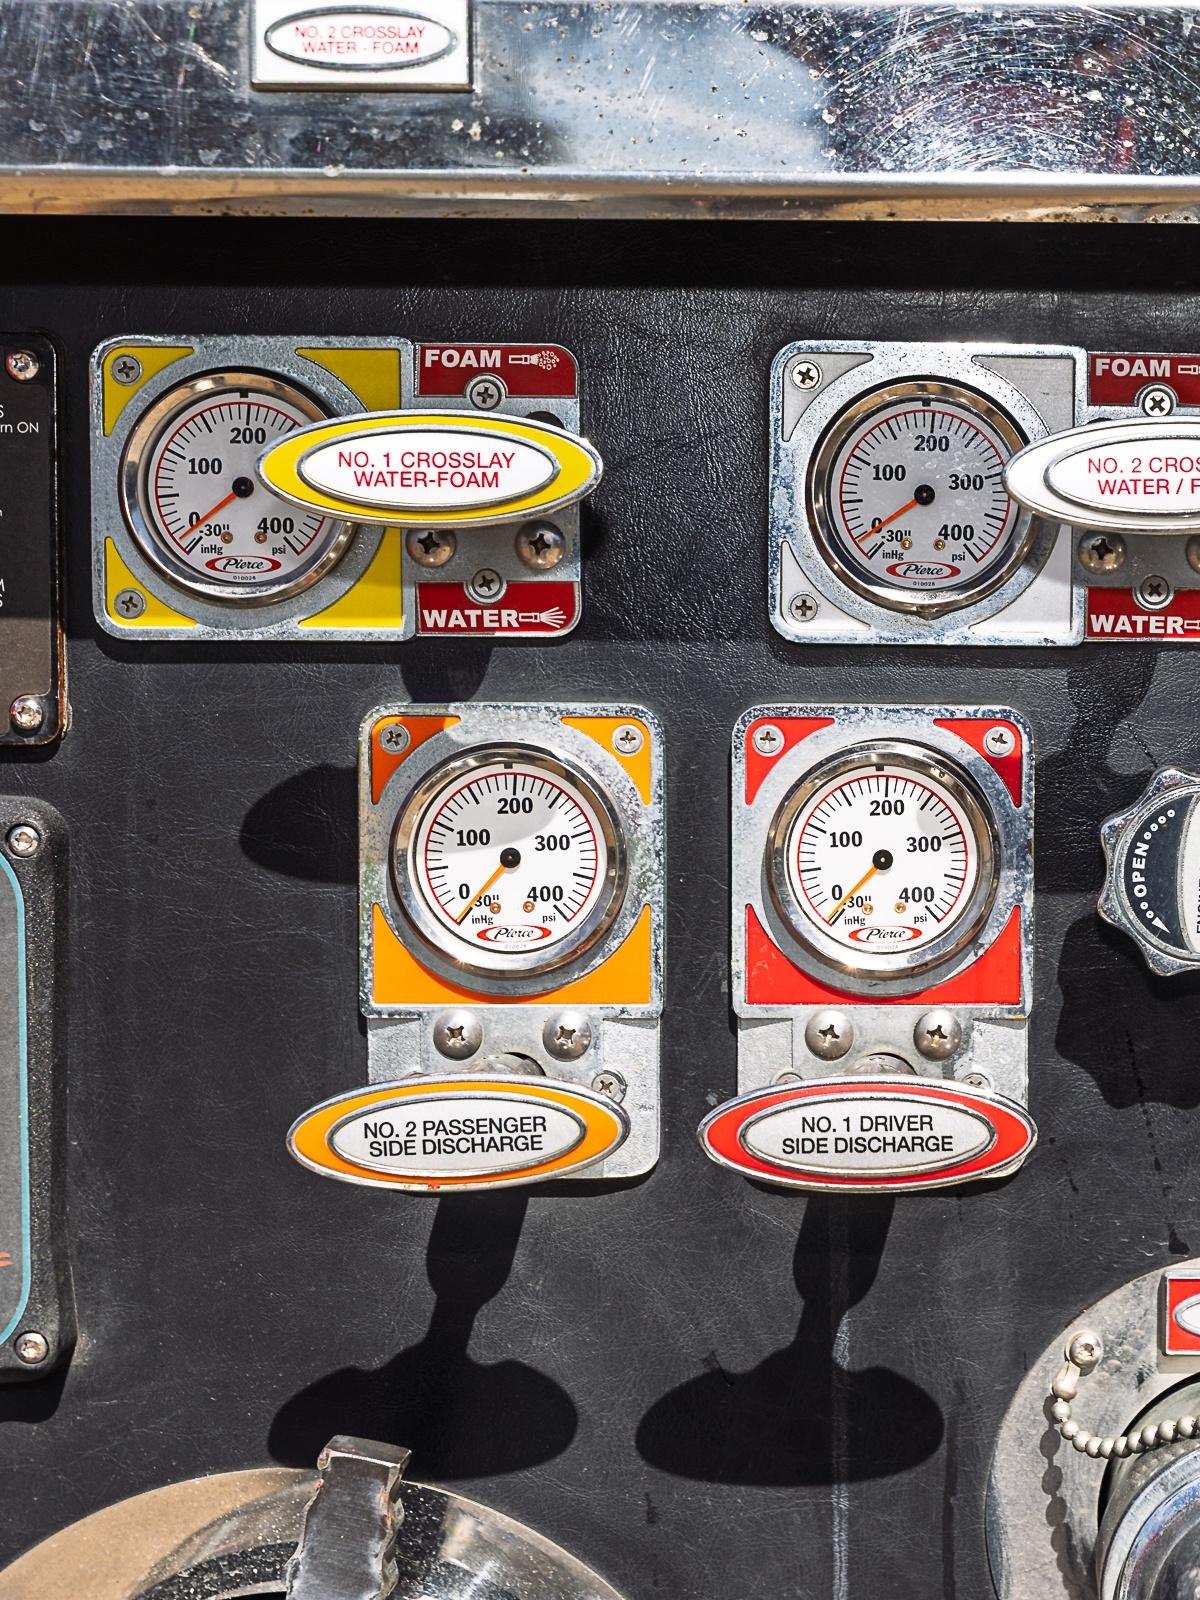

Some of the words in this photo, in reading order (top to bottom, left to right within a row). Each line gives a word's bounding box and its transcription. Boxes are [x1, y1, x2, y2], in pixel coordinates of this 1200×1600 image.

[328, 26, 336, 38] 2
[341, 26, 425, 38] CROSSLAY
[303, 42, 357, 54] WATER
[373, 42, 419, 54] FOAM
[425, 350, 501, 367] FOAM
[1095, 359, 1170, 377] FOAM
[17, 421, 39, 433] ON
[229, 427, 266, 444] 200
[914, 435, 950, 452] 200
[188, 458, 222, 474] 100
[338, 452, 375, 468] NO.
[383, 453, 390, 467] 1
[401, 452, 515, 468] CROSSLAY
[1088, 458, 1123, 474] NO.
[1131, 458, 1142, 473] 2
[354, 471, 499, 488] WATER-FOAM
[873, 465, 906, 481] 100
[949, 474, 984, 491] 300
[1098, 479, 1170, 495] WATER
[1176, 478, 1184, 495] /
[257, 517, 294, 534] 400
[938, 524, 974, 541] 400
[201, 544, 223, 555] inHg
[272, 545, 286, 555] psi
[882, 550, 904, 561] inHg
[952, 551, 965, 562] psi
[223, 558, 264, 570] Pierce
[903, 563, 943, 576] Pierce
[423, 609, 520, 628] WATER
[1090, 614, 1184, 635] WATER
[497, 797, 533, 814] 200
[869, 800, 904, 816] 200
[456, 829, 490, 846] 100
[535, 834, 570, 851] 300
[830, 831, 862, 848] 100
[906, 836, 942, 852] 300
[1131, 842, 1150, 898] OPEN
[459, 883, 470, 899] 0
[527, 885, 563, 902] 400
[831, 884, 842, 900] 0
[899, 887, 934, 903] 400
[471, 915, 494, 925] inHg
[542, 913, 556, 923] psi
[844, 916, 866, 926] inHg
[914, 914, 927, 923] psi
[866, 928, 905, 940] Pierce
[364, 1122, 400, 1139] NO.
[405, 1121, 417, 1137] 2
[423, 1116, 547, 1136] PASSENGER
[801, 1116, 837, 1133] NO.
[843, 1116, 850, 1132] 1
[860, 1115, 933, 1132] DRIVER
[369, 1139, 416, 1157] SIDE
[422, 1135, 543, 1155] DISCHARGE
[782, 1138, 828, 1154] SIDE
[834, 1135, 954, 1154] DISCHARGE
